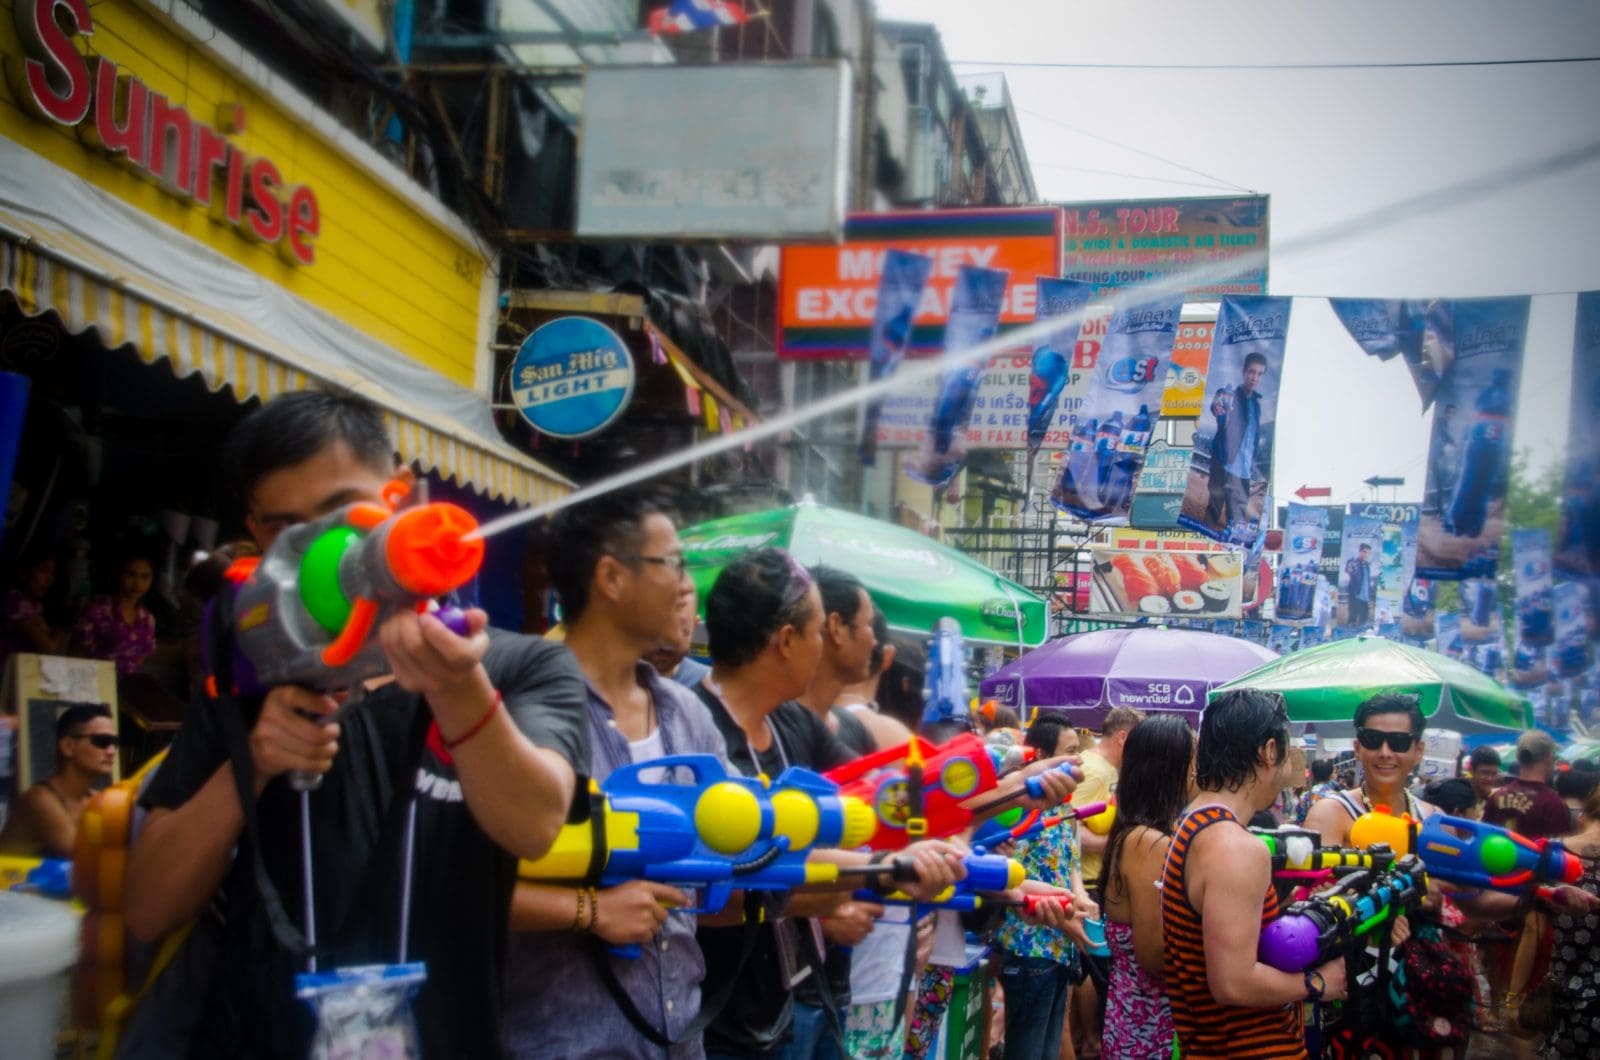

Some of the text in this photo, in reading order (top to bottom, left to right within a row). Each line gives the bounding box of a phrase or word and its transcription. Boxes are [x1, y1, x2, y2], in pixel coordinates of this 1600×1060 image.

[26, 0, 320, 266] Sunrise
[1116, 206, 1180, 233] TOUR
[527, 375, 608, 403] LIGHT
[1148, 683, 1171, 694] SCB
